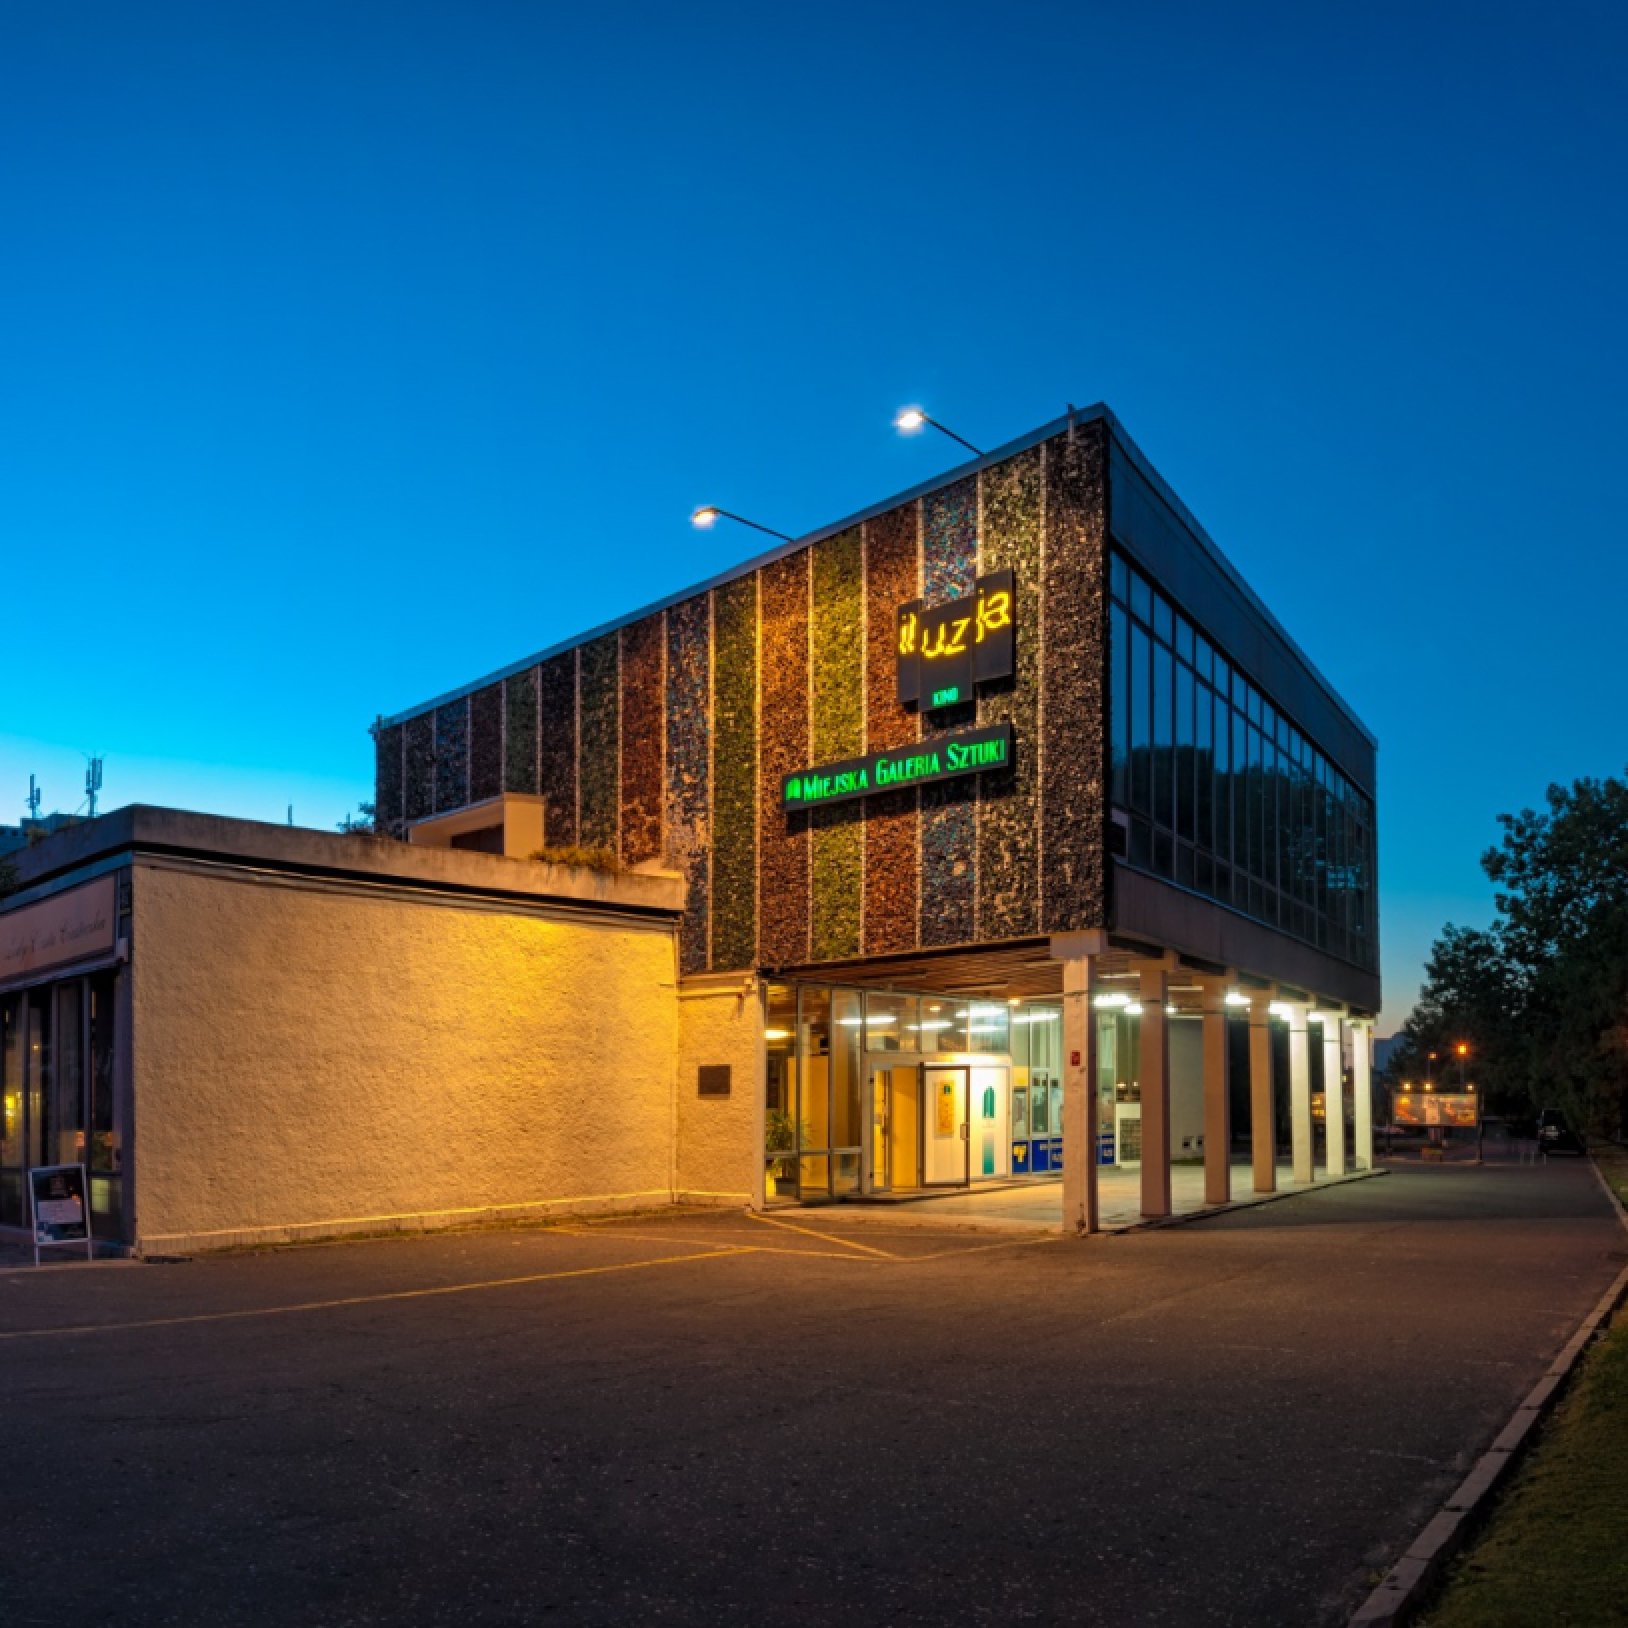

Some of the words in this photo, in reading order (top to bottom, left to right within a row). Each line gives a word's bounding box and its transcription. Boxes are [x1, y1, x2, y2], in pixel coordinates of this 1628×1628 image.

[898, 588, 1011, 659] iluzja
[803, 769, 868, 802] MIEJSKA
[875, 752, 941, 785] GALERIA
[946, 739, 1005, 771] SZTUKI
